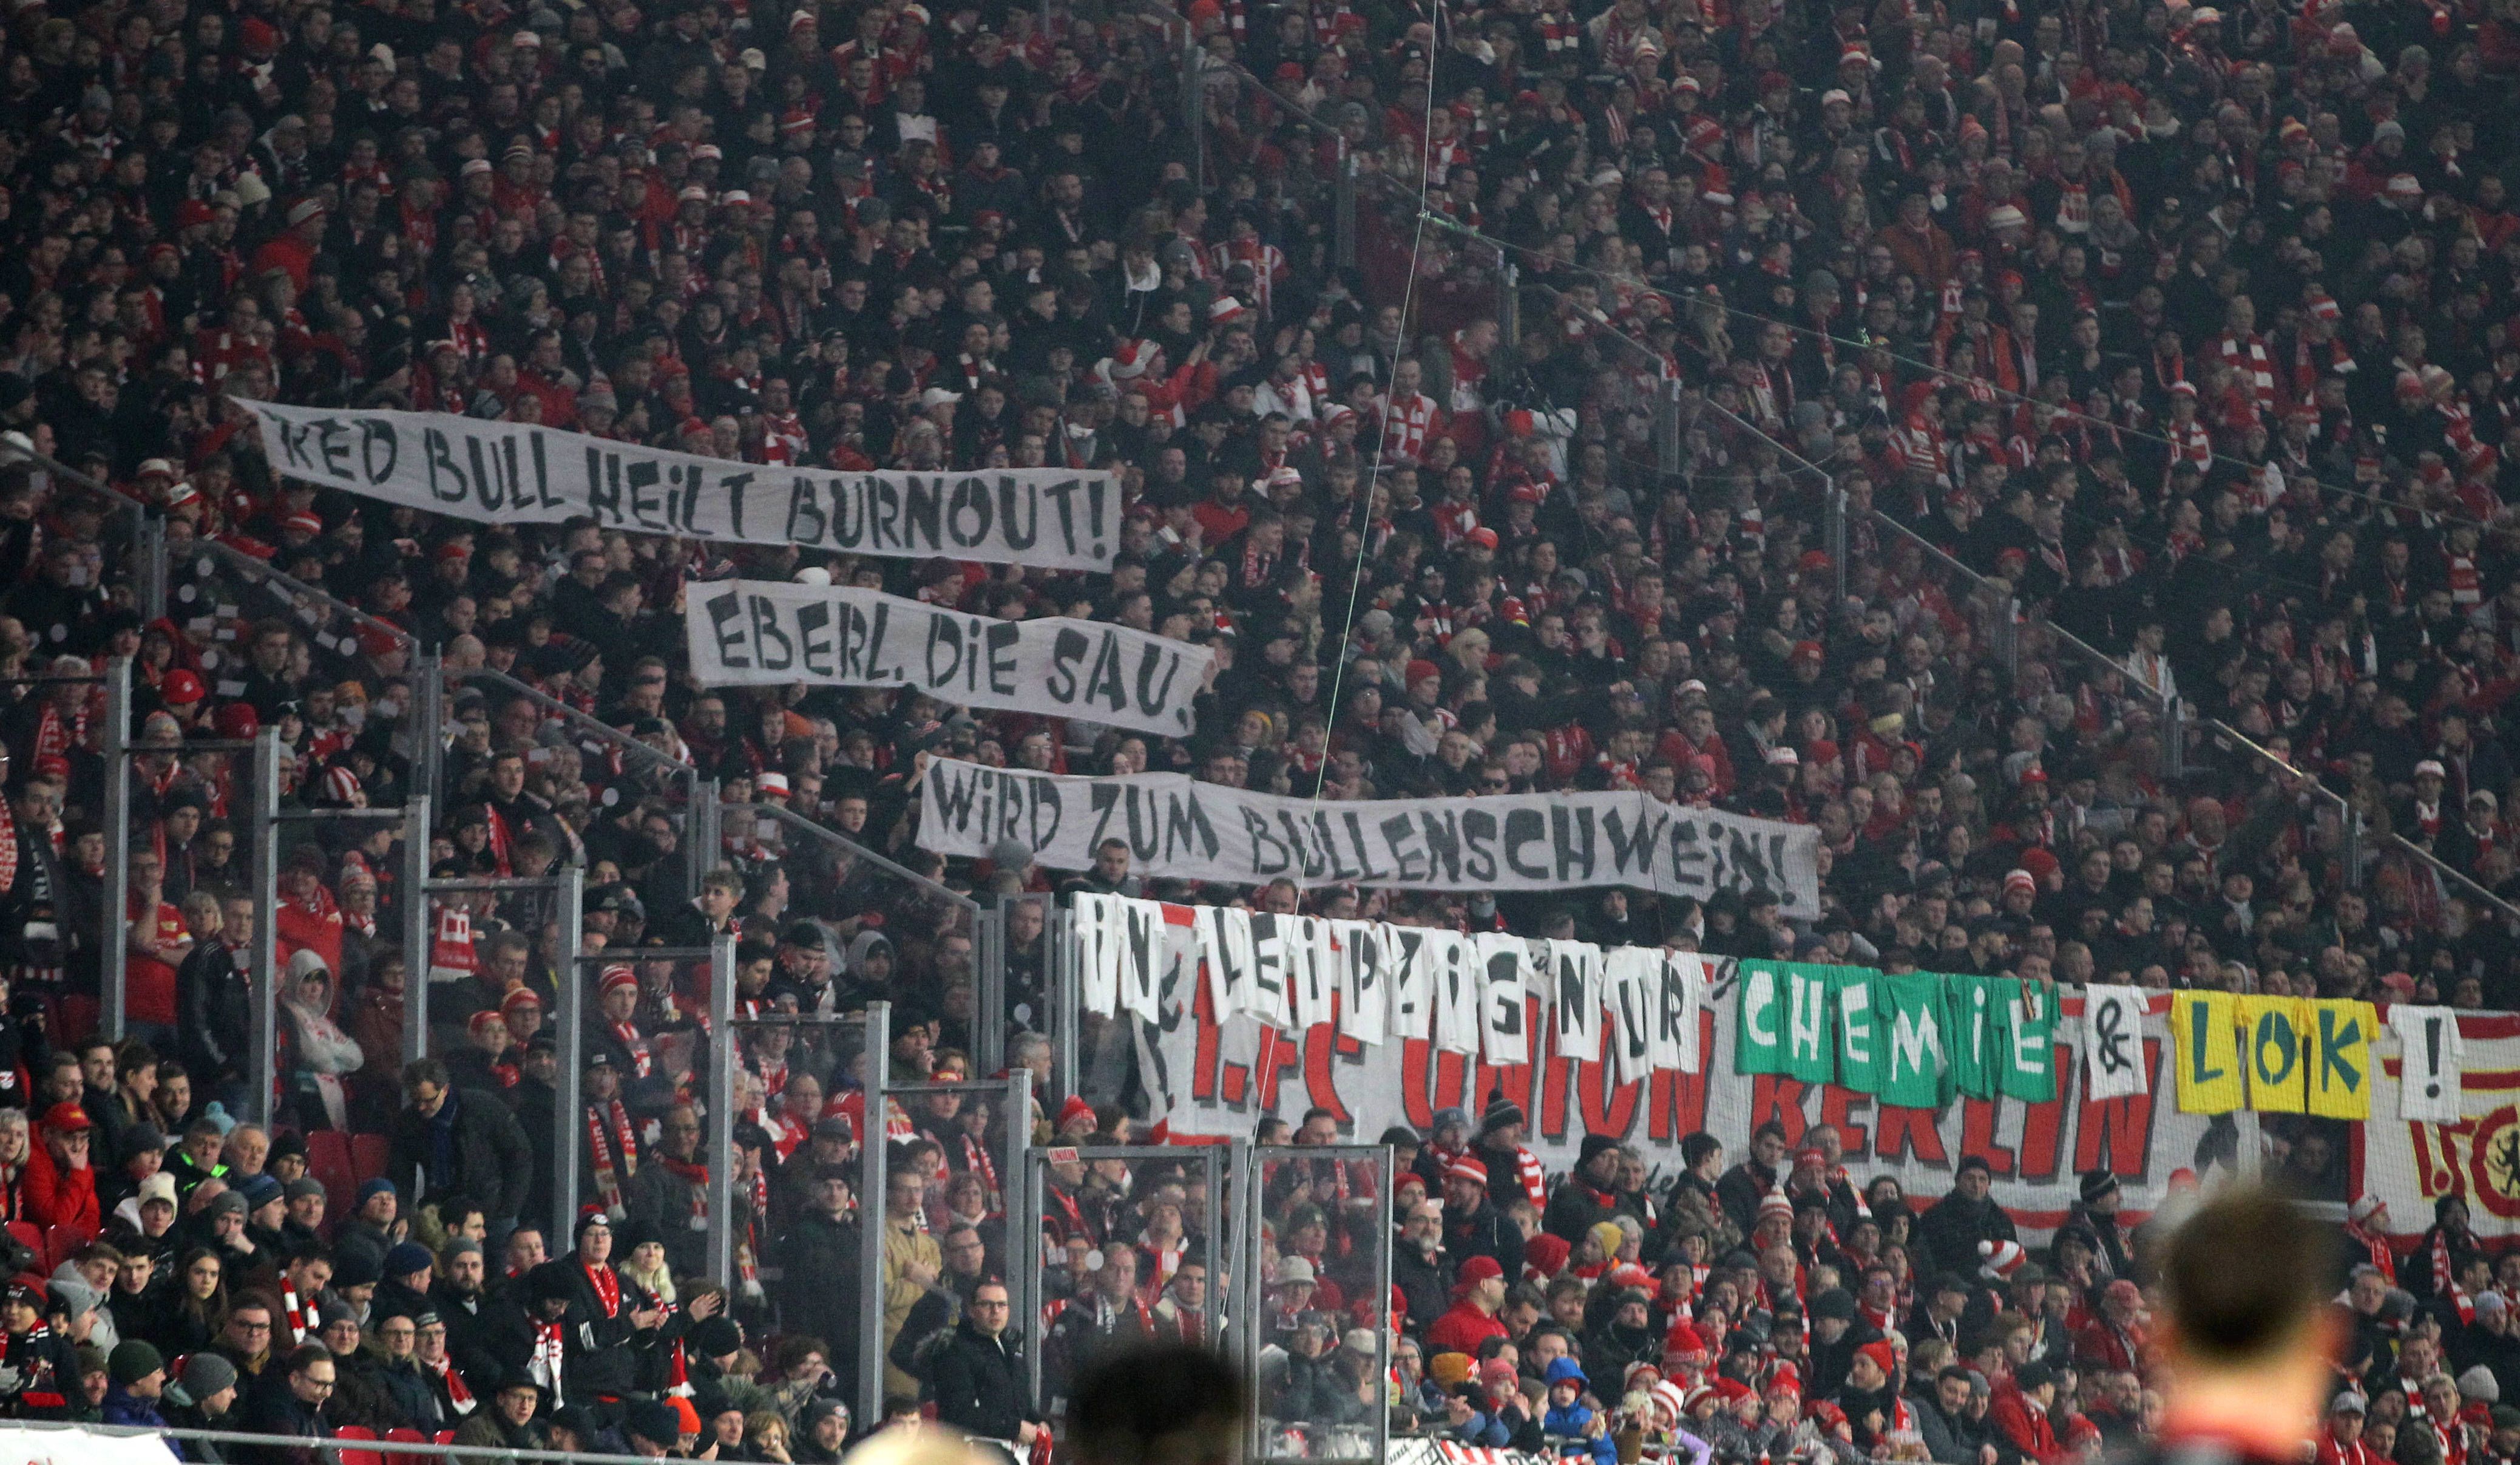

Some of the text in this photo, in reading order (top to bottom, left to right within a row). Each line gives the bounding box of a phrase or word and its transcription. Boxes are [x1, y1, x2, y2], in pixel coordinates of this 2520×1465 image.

[259, 408, 398, 485] RED
[427, 427, 565, 511] BULL
[785, 475, 1105, 560] BURNOUT!
[1088, 782, 1221, 863] ZUM
[1560, 953, 1684, 1058] NUR
[2095, 997, 2133, 1074] &
[2191, 1001, 2362, 1094] LOK
